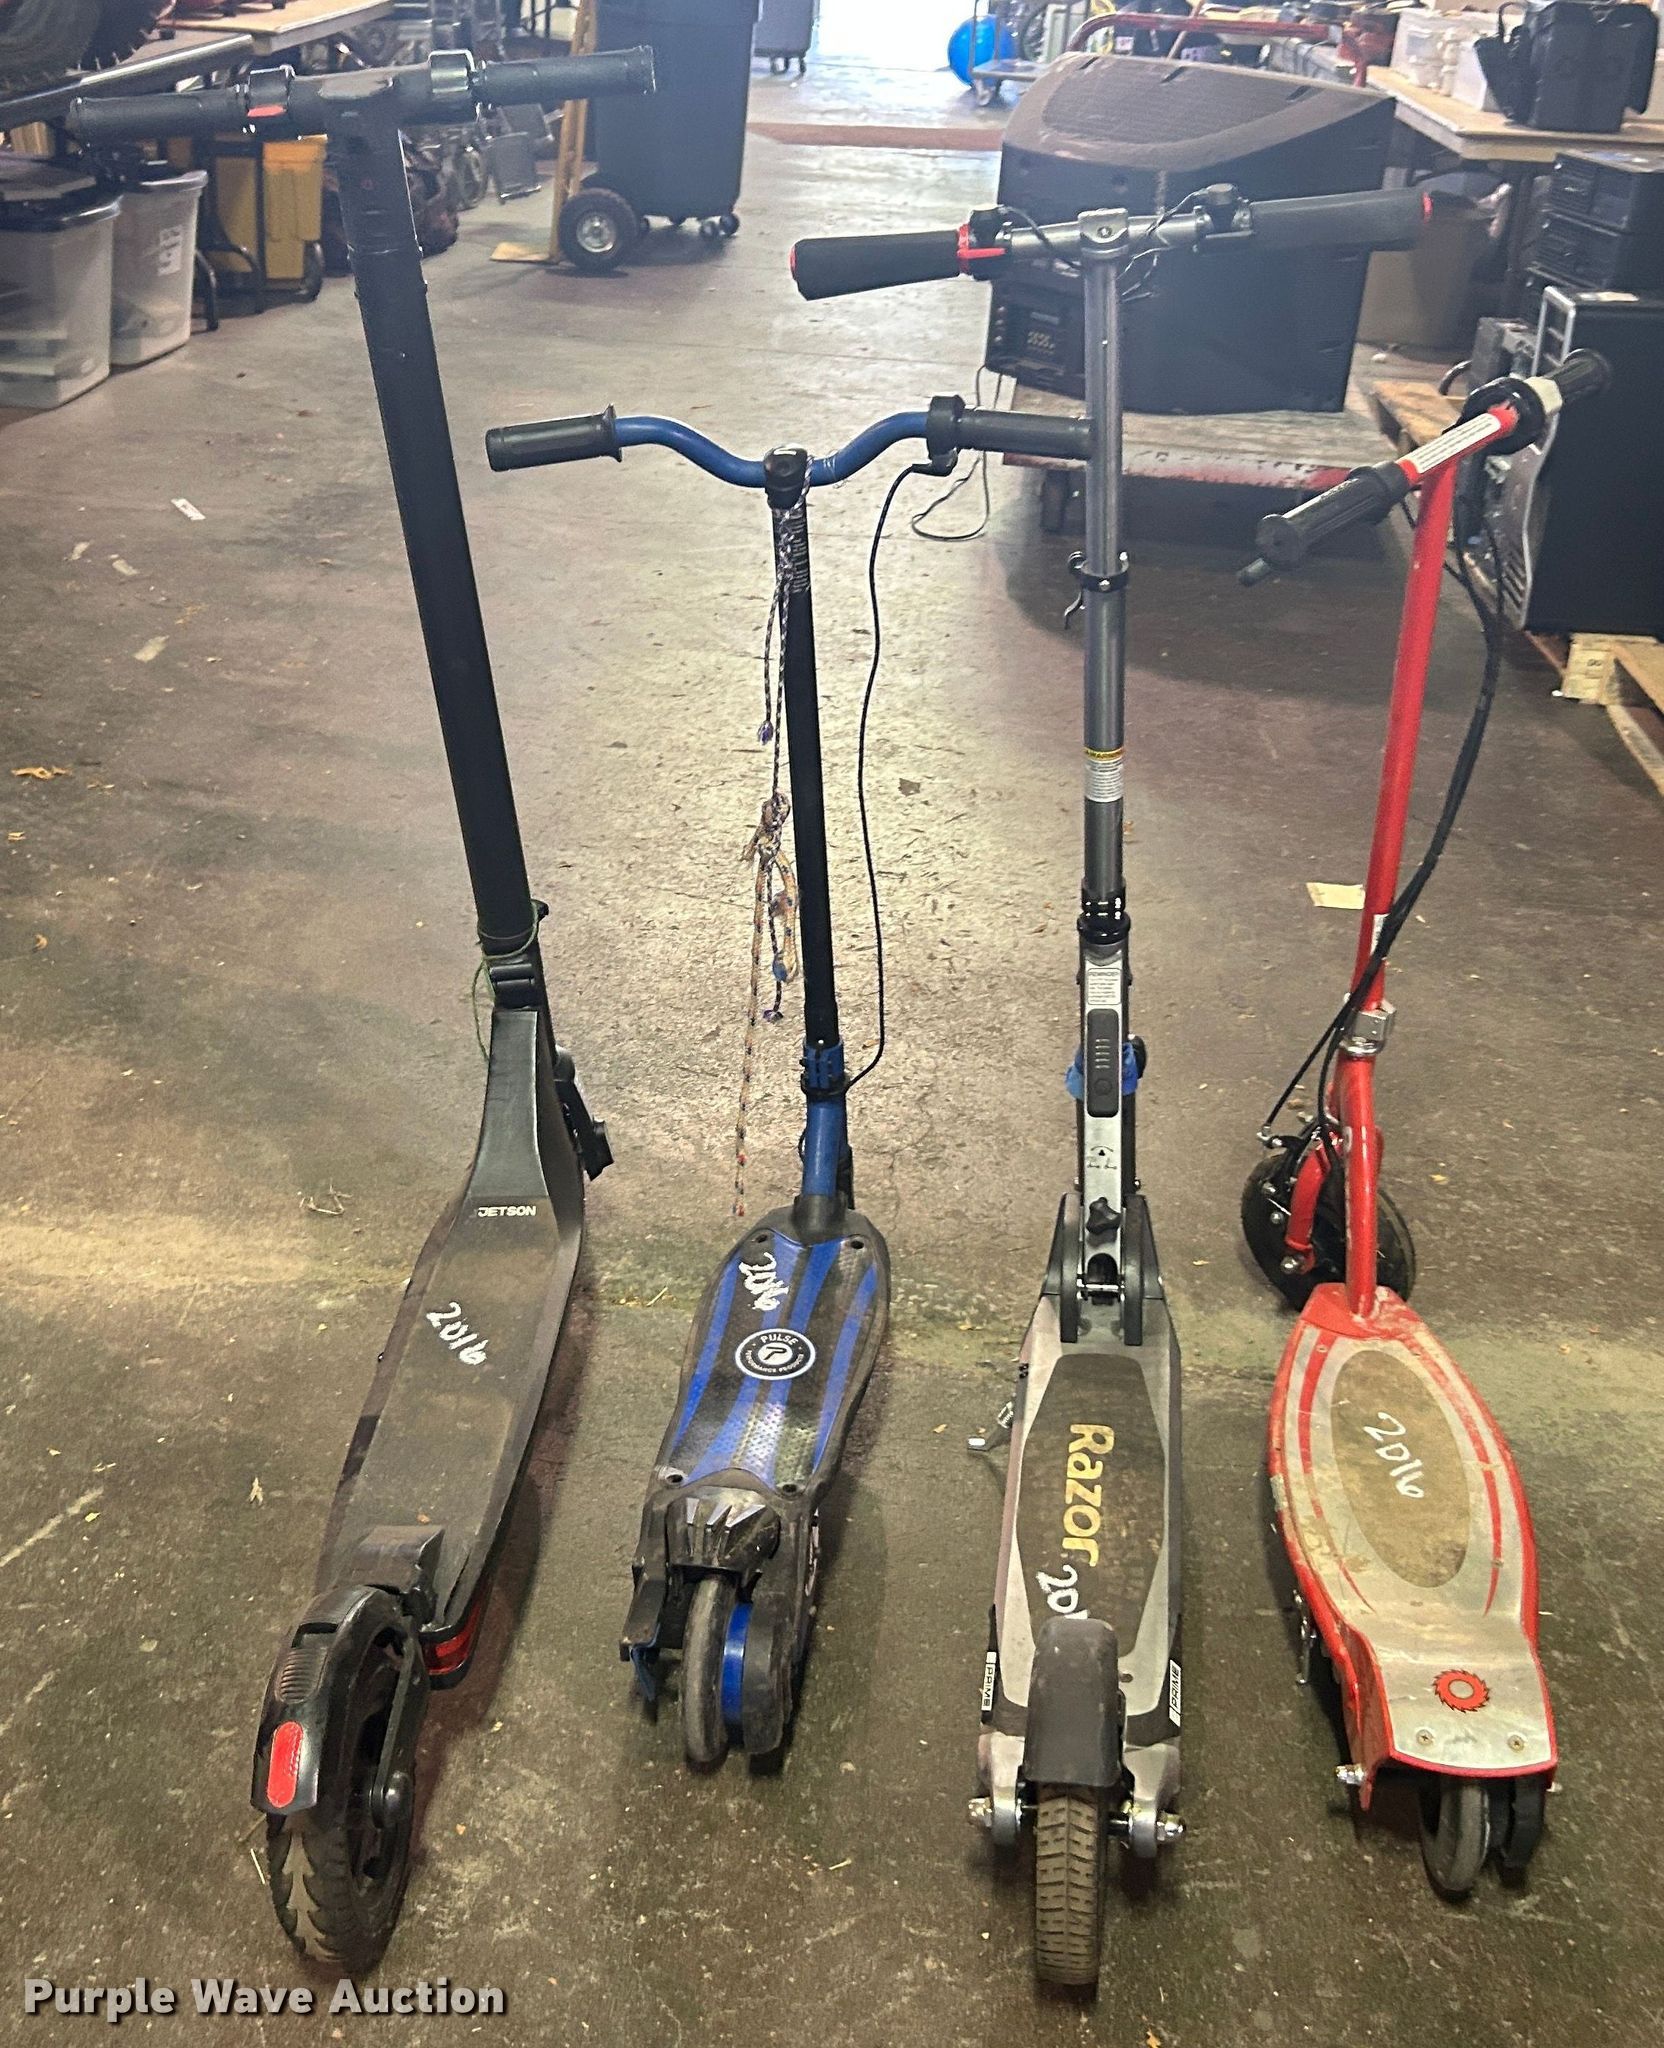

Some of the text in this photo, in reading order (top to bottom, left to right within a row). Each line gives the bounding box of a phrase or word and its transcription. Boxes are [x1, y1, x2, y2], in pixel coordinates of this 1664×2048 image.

[477, 1205, 537, 1217] JETSON
[426, 1301, 488, 1366] 2016
[760, 1333, 799, 1346] PULSE
[1363, 1411, 1425, 1499] 2016
[1062, 1424, 1115, 1567] Razor
[982, 1666, 994, 1707] PRIME
[1171, 1664, 1180, 1709] PRIME
